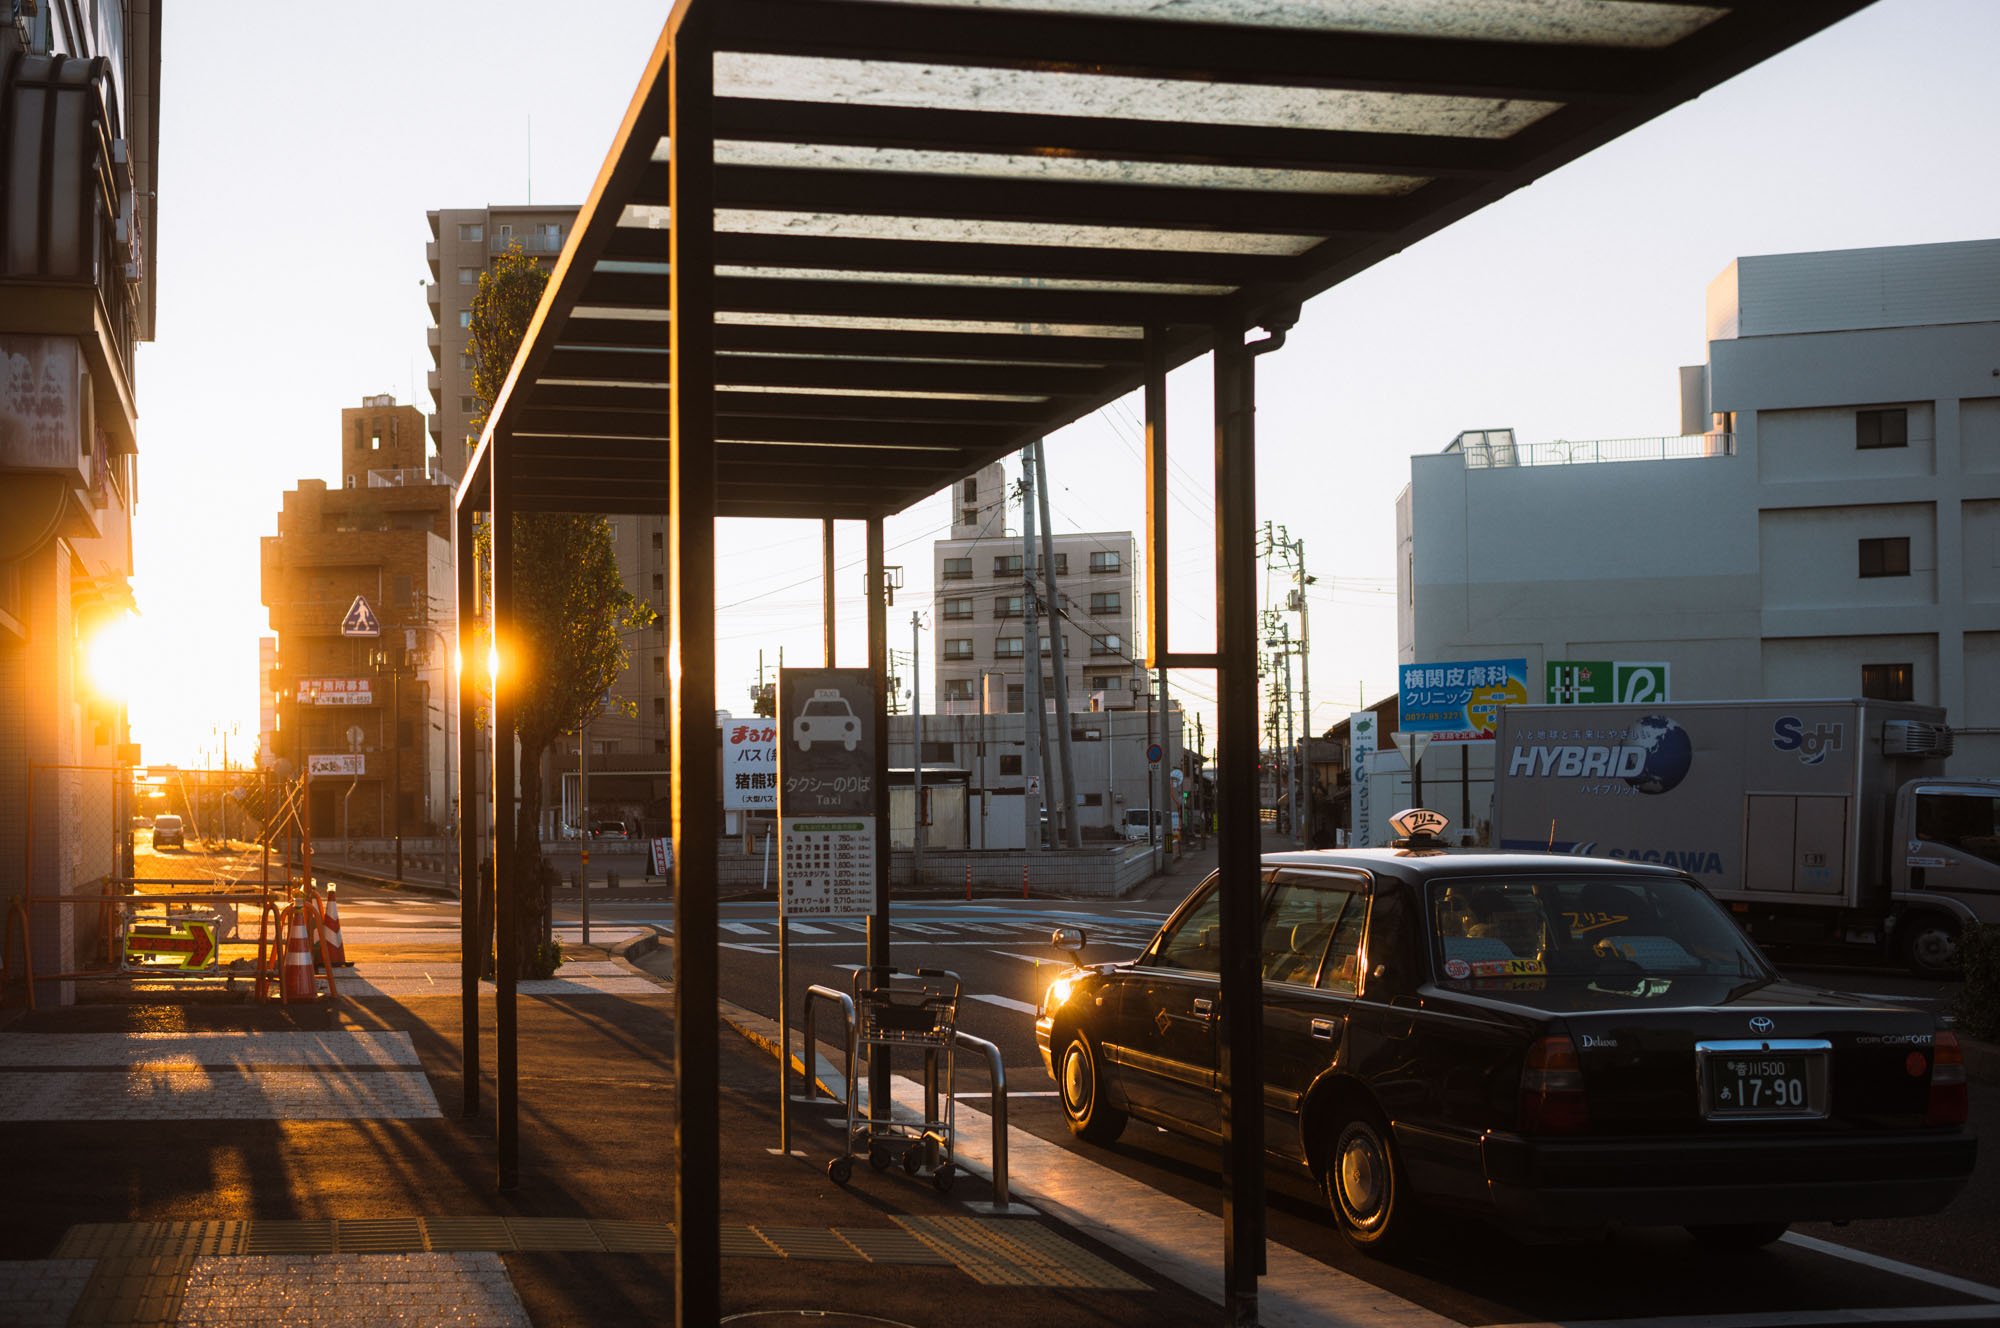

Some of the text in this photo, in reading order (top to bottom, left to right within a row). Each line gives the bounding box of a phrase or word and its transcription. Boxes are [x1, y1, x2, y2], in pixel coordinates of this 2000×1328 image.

[1404, 665, 1508, 690] 横関皮膚科
[1406, 688, 1474, 706] クリニック
[1508, 745, 1648, 778] HYBRID
[786, 776, 872, 793] タクシーのりば
[1580, 784, 1640, 797] ハイブリッド
[816, 794, 841, 805] Taxi
[1581, 1034, 1618, 1047] Deluxe
[1881, 1034, 1933, 1044] COMFORT
[1719, 1078, 1803, 1106] あ 17-90
